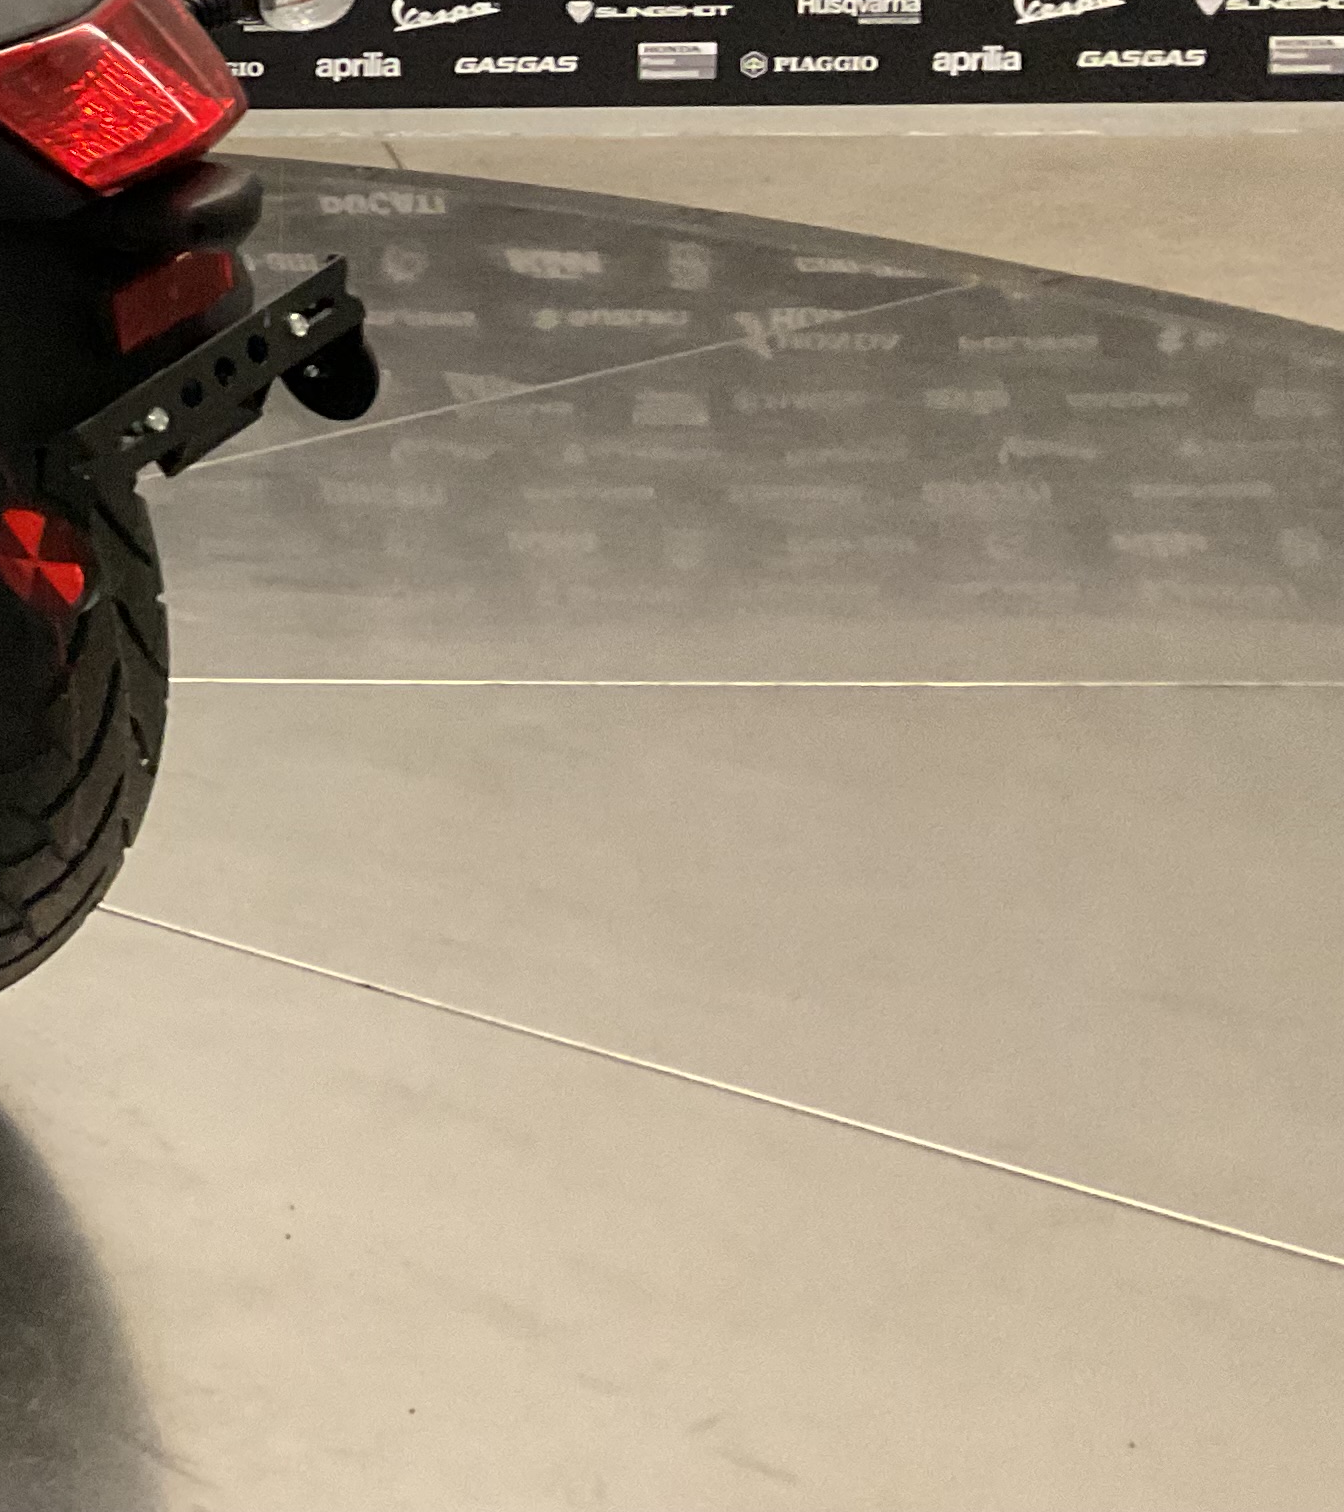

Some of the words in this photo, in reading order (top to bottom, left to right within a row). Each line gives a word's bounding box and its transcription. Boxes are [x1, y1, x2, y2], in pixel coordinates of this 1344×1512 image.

[595, 5, 733, 18] SLINGSHOT
[315, 52, 401, 82] aprilia
[455, 56, 578, 73] GASGAS
[774, 56, 878, 72] PIAGGIO
[932, 45, 1021, 76] aprilia
[1077, 50, 1207, 67] GASGAS
